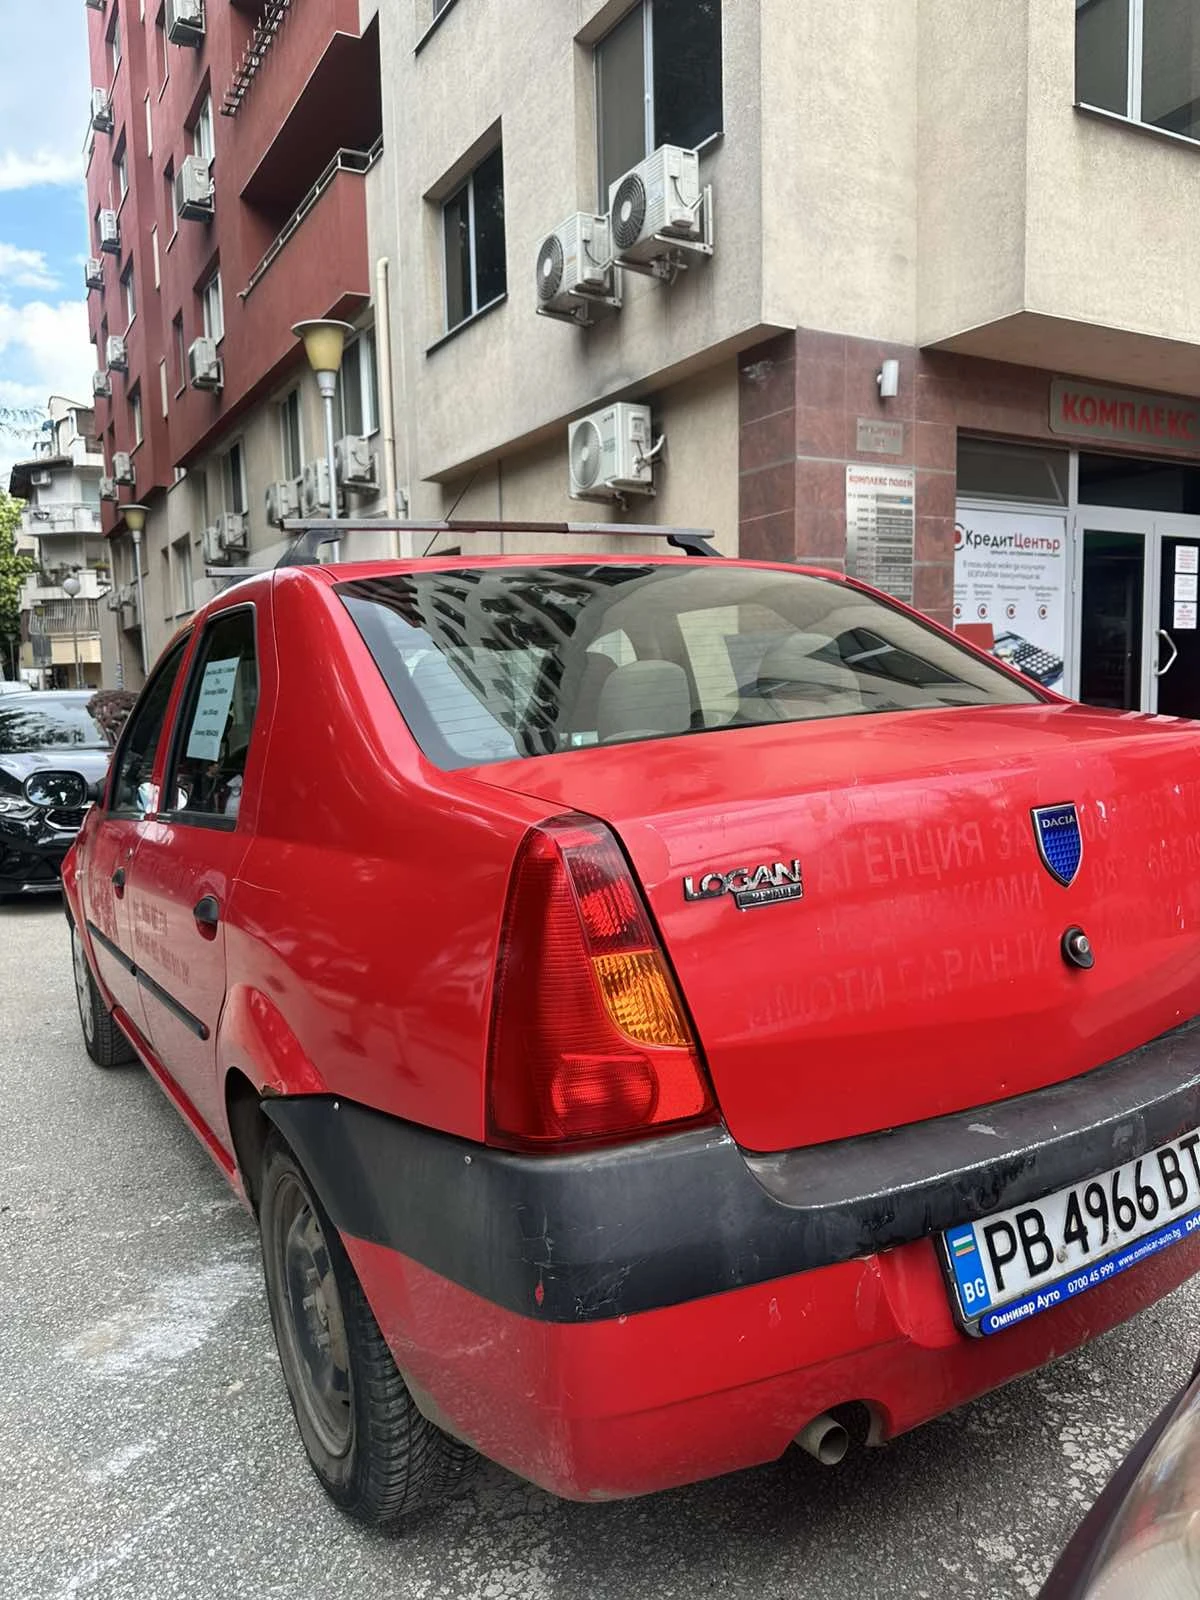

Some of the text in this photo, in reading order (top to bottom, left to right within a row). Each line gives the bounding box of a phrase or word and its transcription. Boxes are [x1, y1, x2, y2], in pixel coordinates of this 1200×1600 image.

[1062, 391, 1198, 440] КОМПЛЕКС
[965, 530, 1060, 551] КредитЦентър
[1041, 815, 1075, 828] DACIA
[683, 859, 802, 901] LOGAN
[983, 1133, 1200, 1292] PB 4966 BT
[963, 1278, 985, 1303] BG
[990, 1302, 1035, 1329] Омникар
[1037, 1290, 1060, 1308] Ауто
[1067, 1275, 1089, 1293] 0700
[1089, 1270, 1100, 1282] 45
[1100, 1262, 1115, 1277] 999
[1118, 1229, 1182, 1267] www.omnicar-auto.bg
